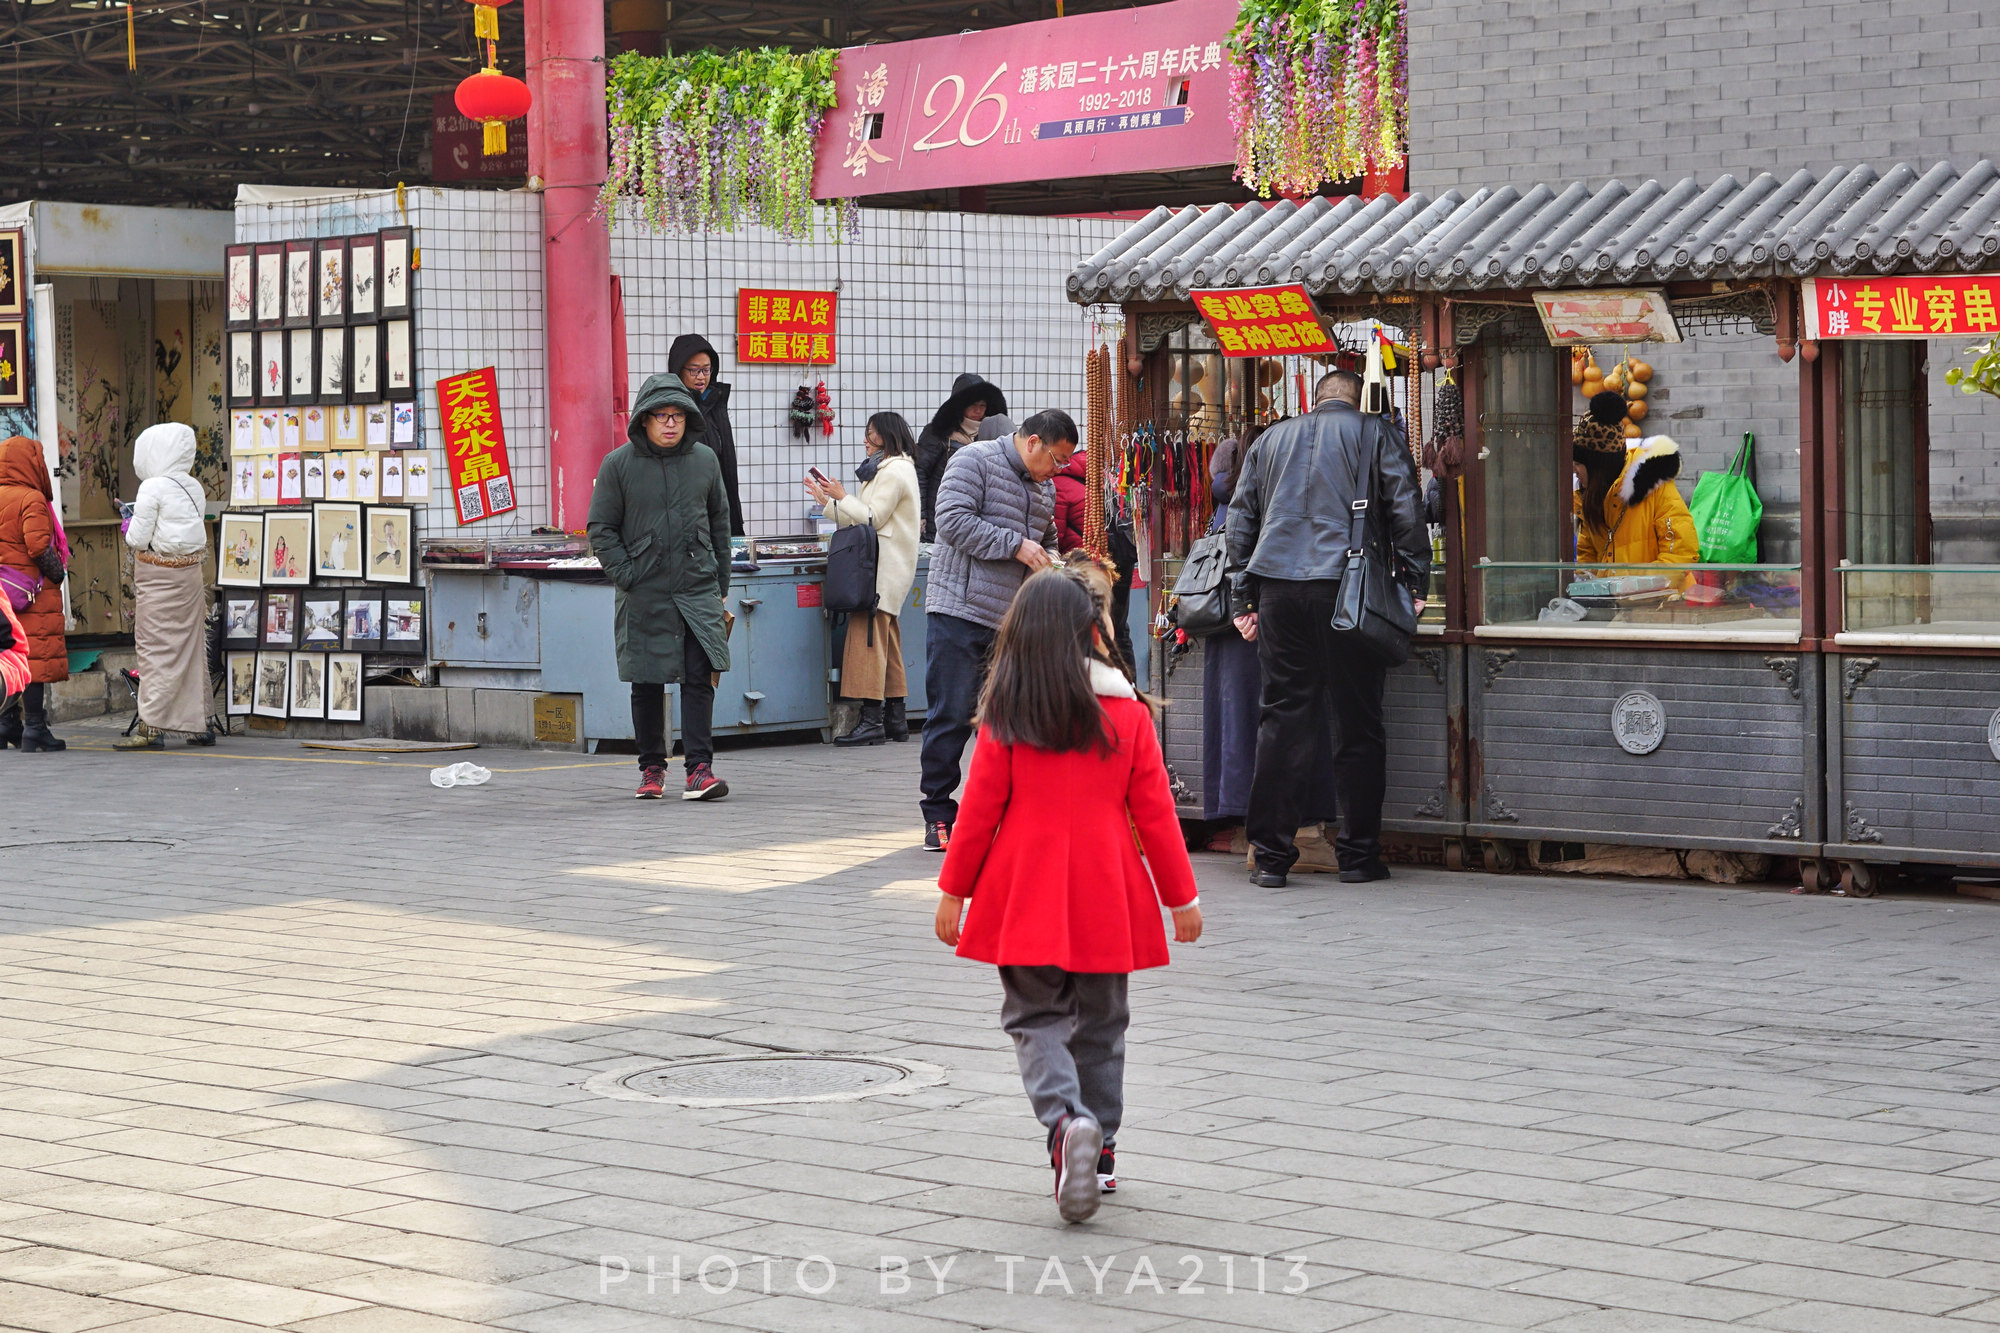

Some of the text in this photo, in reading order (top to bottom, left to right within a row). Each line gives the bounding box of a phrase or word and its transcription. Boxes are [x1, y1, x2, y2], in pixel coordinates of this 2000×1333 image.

[1018, 41, 1221, 94] 潘家园二十六周年庆典
[1078, 87, 1151, 112] 1992-2018
[748, 295, 830, 326] 翡翠A货
[1200, 290, 1310, 321] 专业穿串
[1826, 283, 1850, 335] 小胖
[1853, 284, 1998, 333] 专业穿串
[748, 331, 830, 360] 质量保真
[1216, 320, 1327, 351] 各种配饰
[446, 374, 500, 486] 天然水晶
